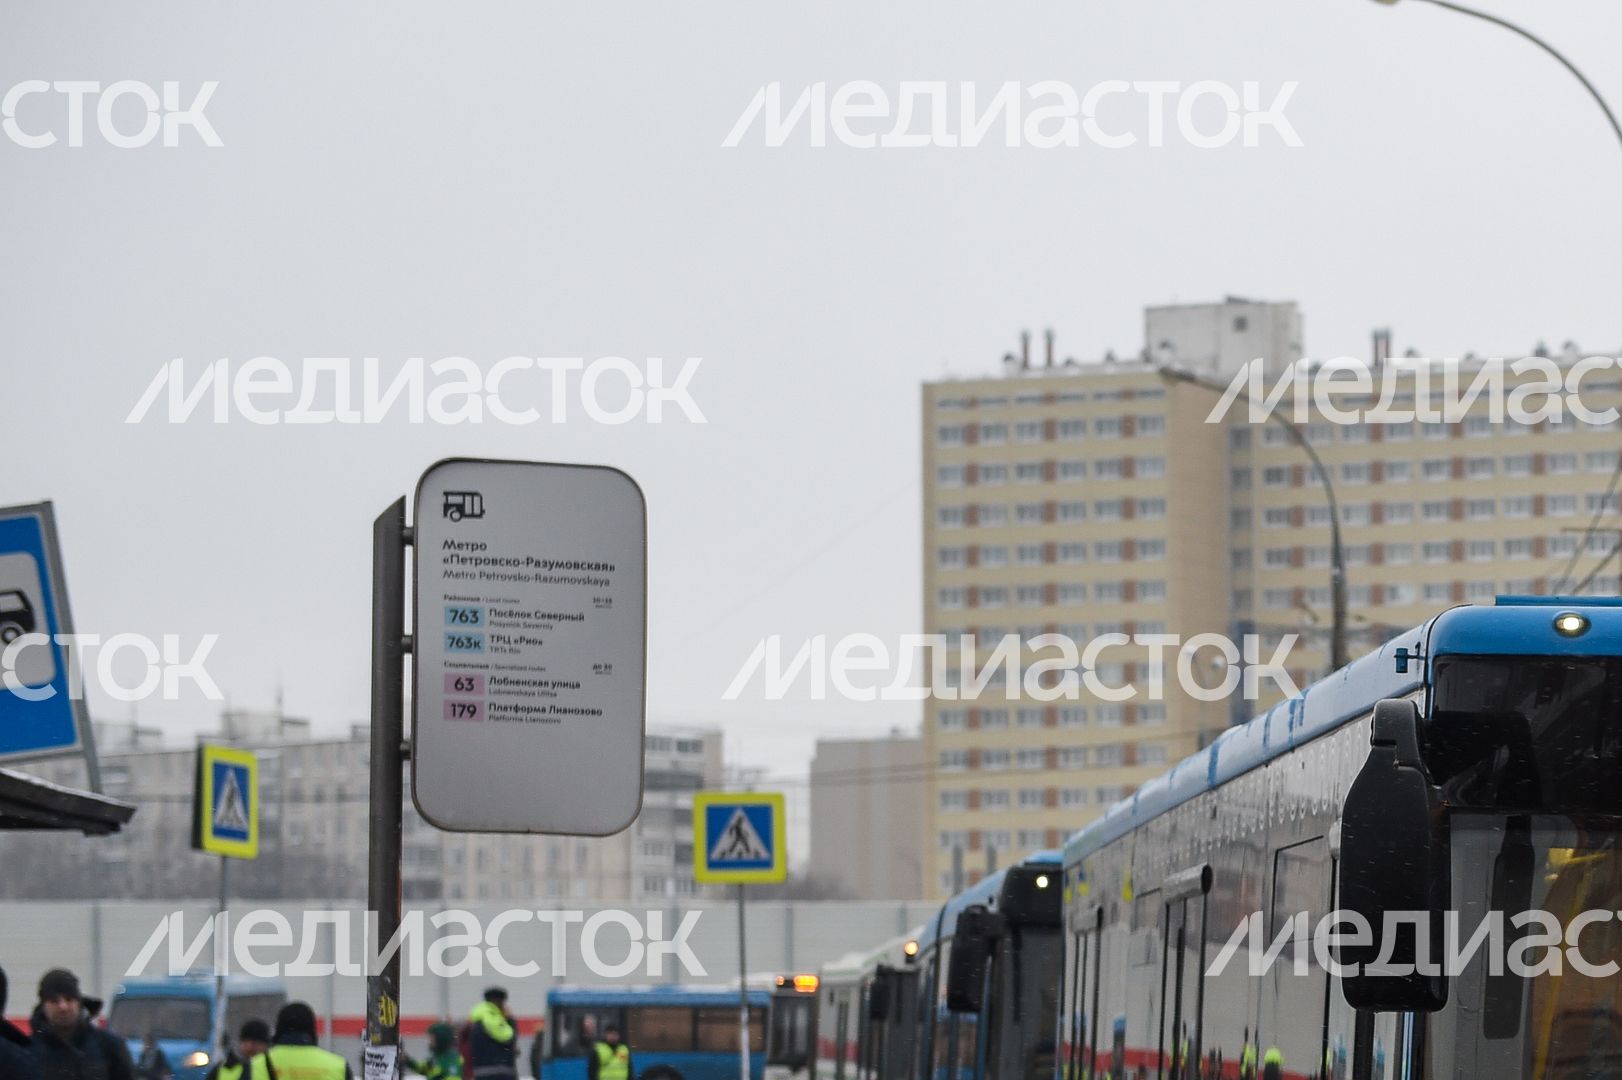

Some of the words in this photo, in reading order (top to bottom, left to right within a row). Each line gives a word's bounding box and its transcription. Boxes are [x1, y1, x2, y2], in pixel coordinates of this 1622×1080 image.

[442, 539, 487, 552] Метро
[442, 554, 616, 572] «Петровско-Разумовская»
[442, 569, 477, 580] Metro
[479, 570, 611, 588] Petrovsko-Razumovskaya
[449, 609, 480, 624] 763
[534, 610, 585, 622] Северный
[447, 635, 481, 650] 763к
[490, 634, 512, 646] ТРЦ
[454, 677, 475, 692] 63
[488, 676, 549, 688] Лобненская
[551, 680, 581, 690] улица
[450, 703, 477, 719] 179
[488, 702, 547, 716] Платформа
[548, 704, 603, 717] Лианозово
